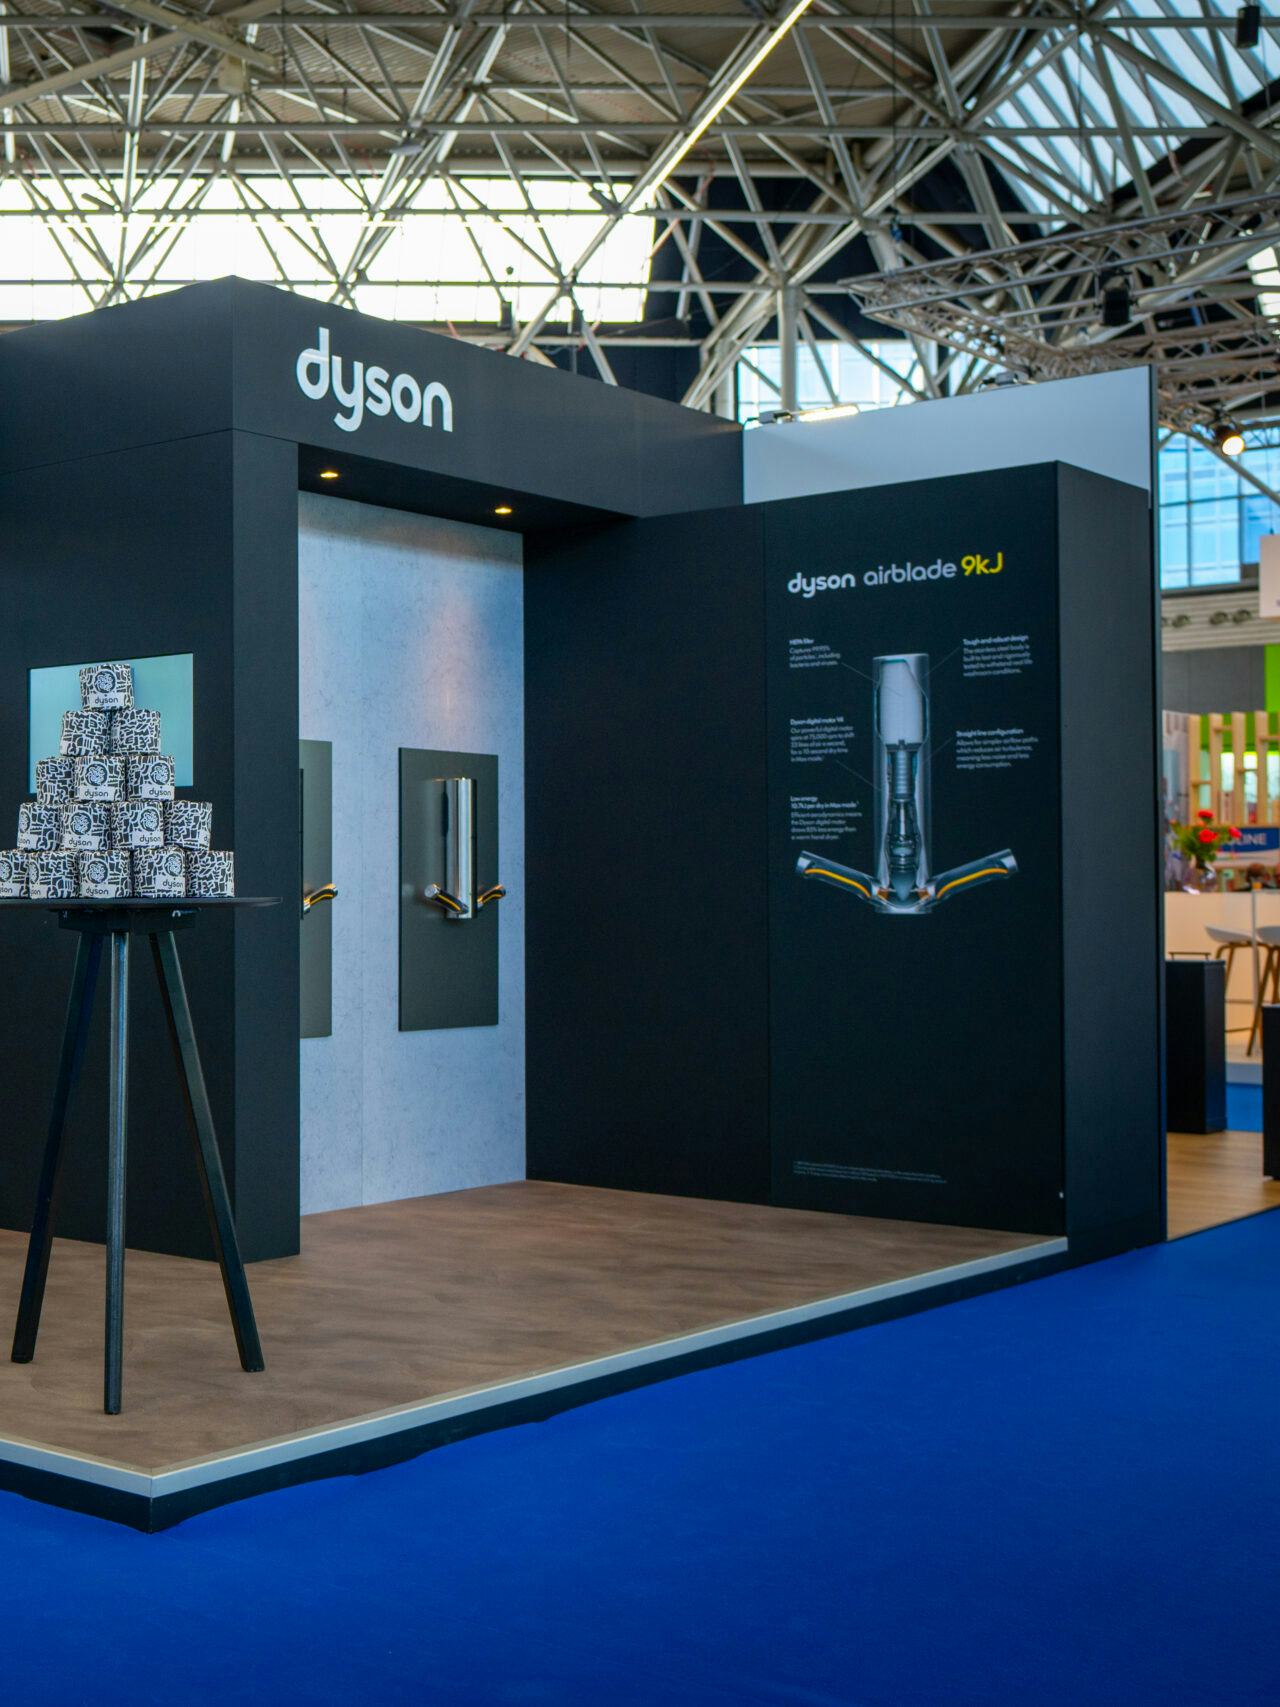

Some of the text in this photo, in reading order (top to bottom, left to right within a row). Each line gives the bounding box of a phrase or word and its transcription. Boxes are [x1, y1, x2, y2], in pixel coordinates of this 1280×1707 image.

[296, 326, 454, 432] dyson
[787, 552, 1004, 598] dyson airblade 9kJ
[94, 696, 120, 706] dyson
[84, 788, 110, 798] dyson
[148, 787, 172, 798] dyson
[68, 837, 92, 848] dyson
[85, 887, 110, 896] dyson
